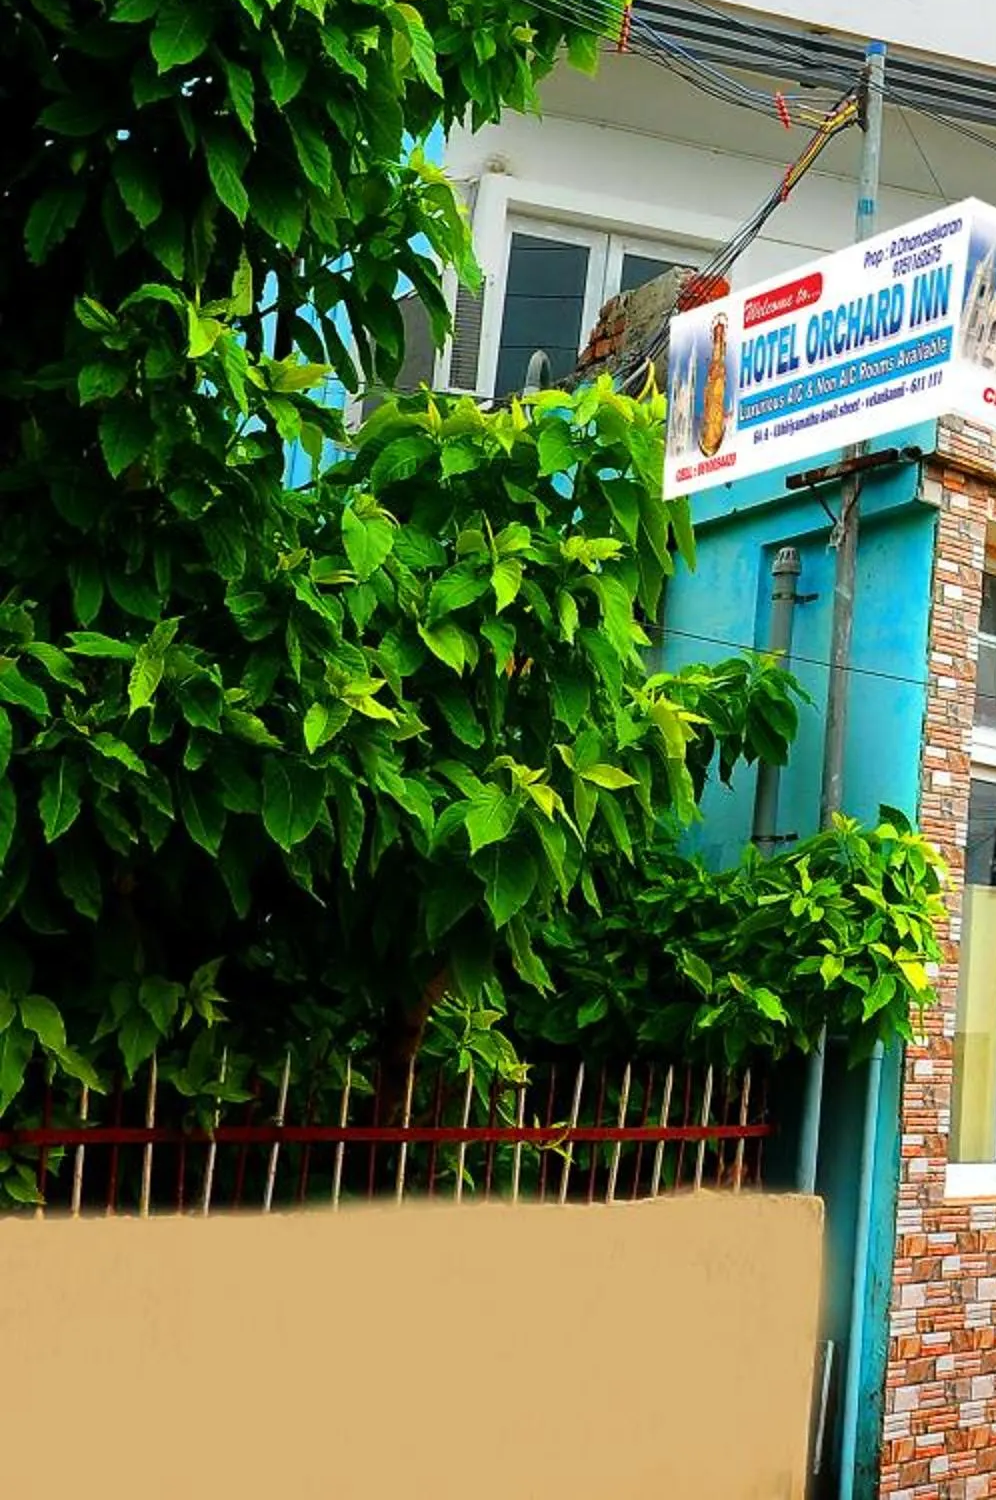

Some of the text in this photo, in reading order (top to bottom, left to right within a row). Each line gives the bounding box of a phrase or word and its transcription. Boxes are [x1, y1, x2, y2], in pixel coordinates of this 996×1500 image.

[740, 263, 953, 389] HOTEL ORCHARD INN
[816, 375, 837, 397] Non
[861, 355, 895, 380] Rooms
[897, 335, 947, 368] Available
